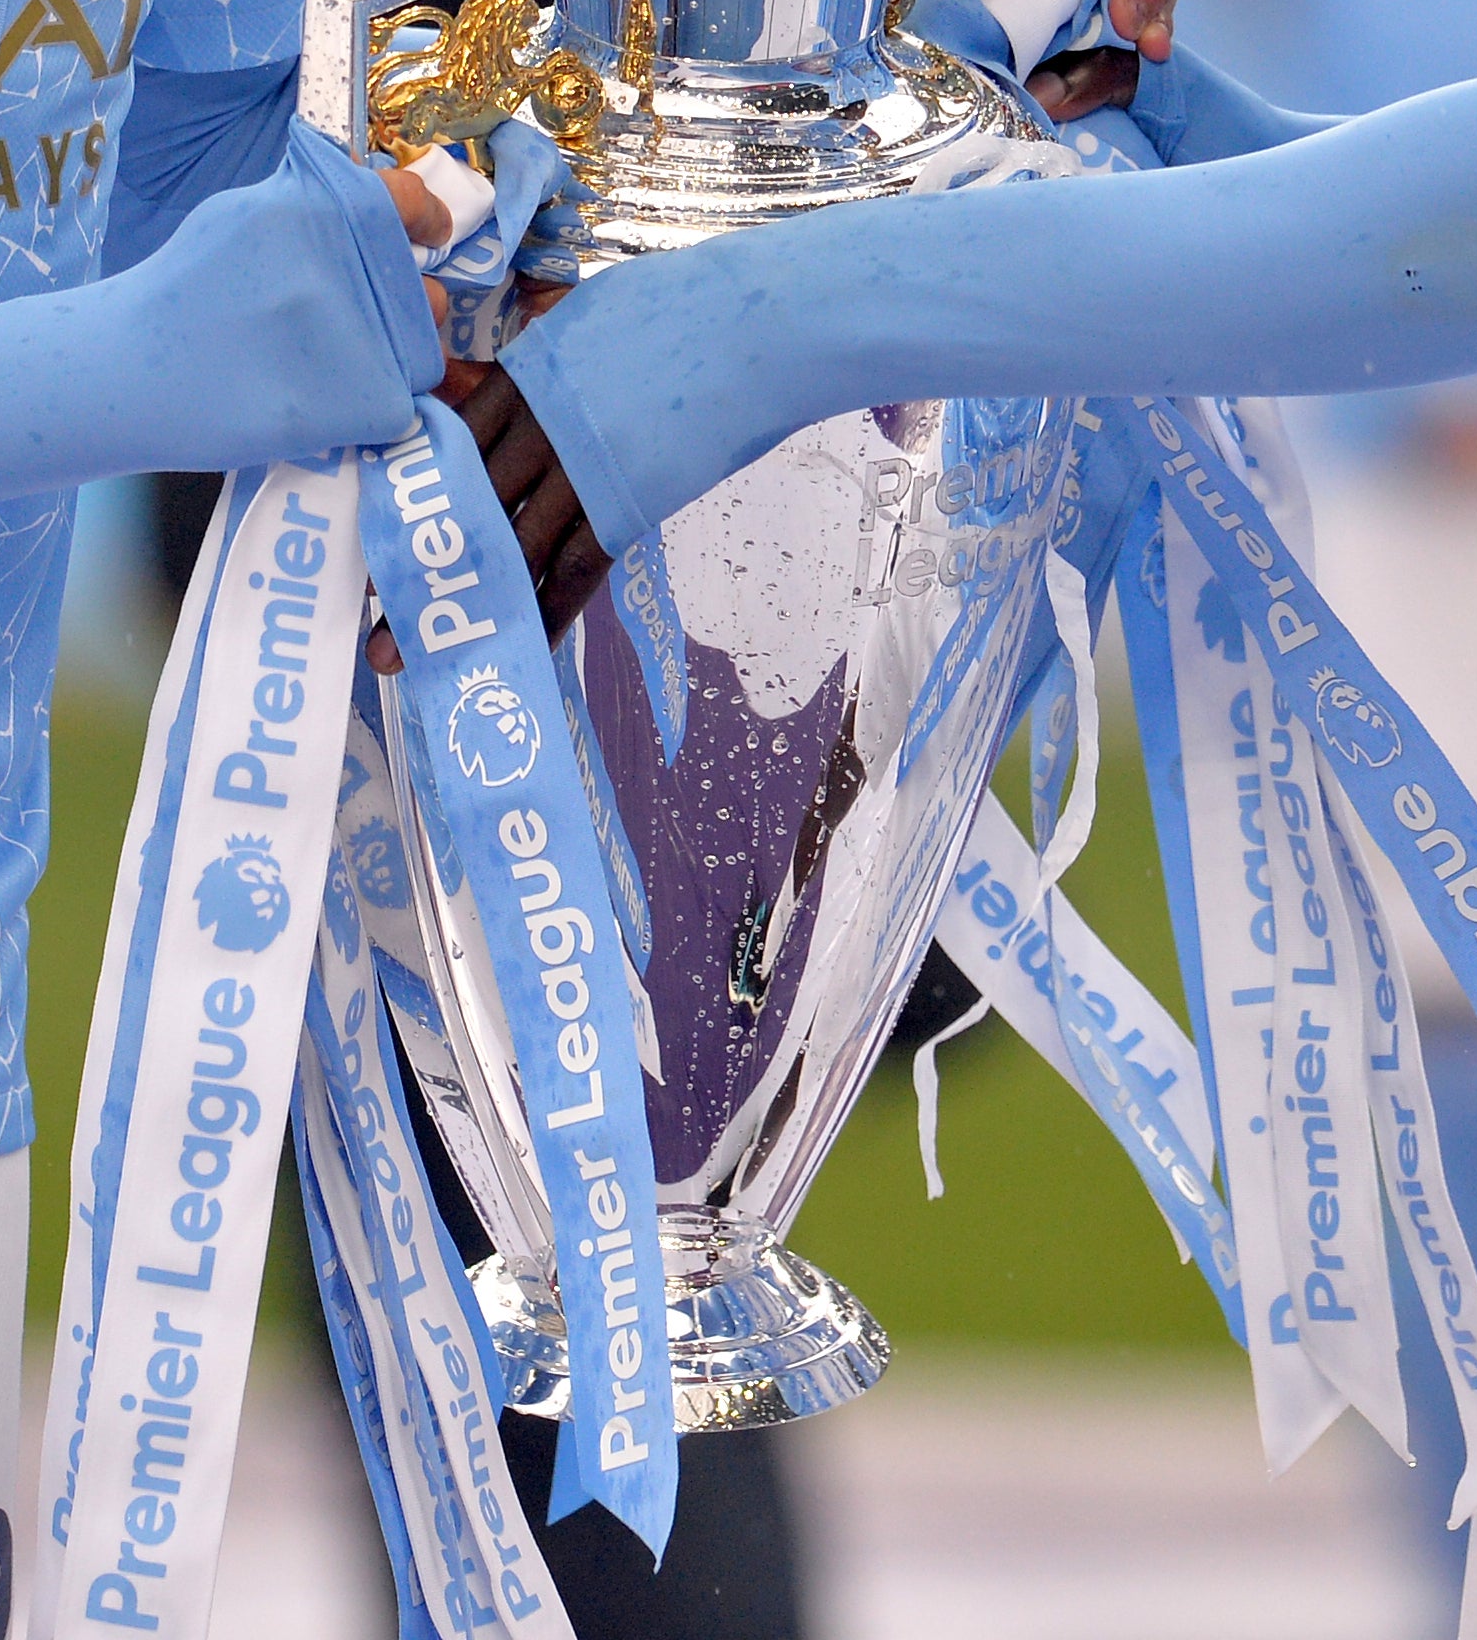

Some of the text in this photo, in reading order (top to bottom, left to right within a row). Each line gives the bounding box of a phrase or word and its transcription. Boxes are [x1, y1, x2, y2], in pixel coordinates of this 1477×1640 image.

[214, 492, 331, 810] Premier
[499, 807, 649, 1473] Premier League
[1285, 1009, 1357, 1323] Premier
[86, 977, 261, 1632] Premier League
[420, 1318, 542, 1621] Premier
